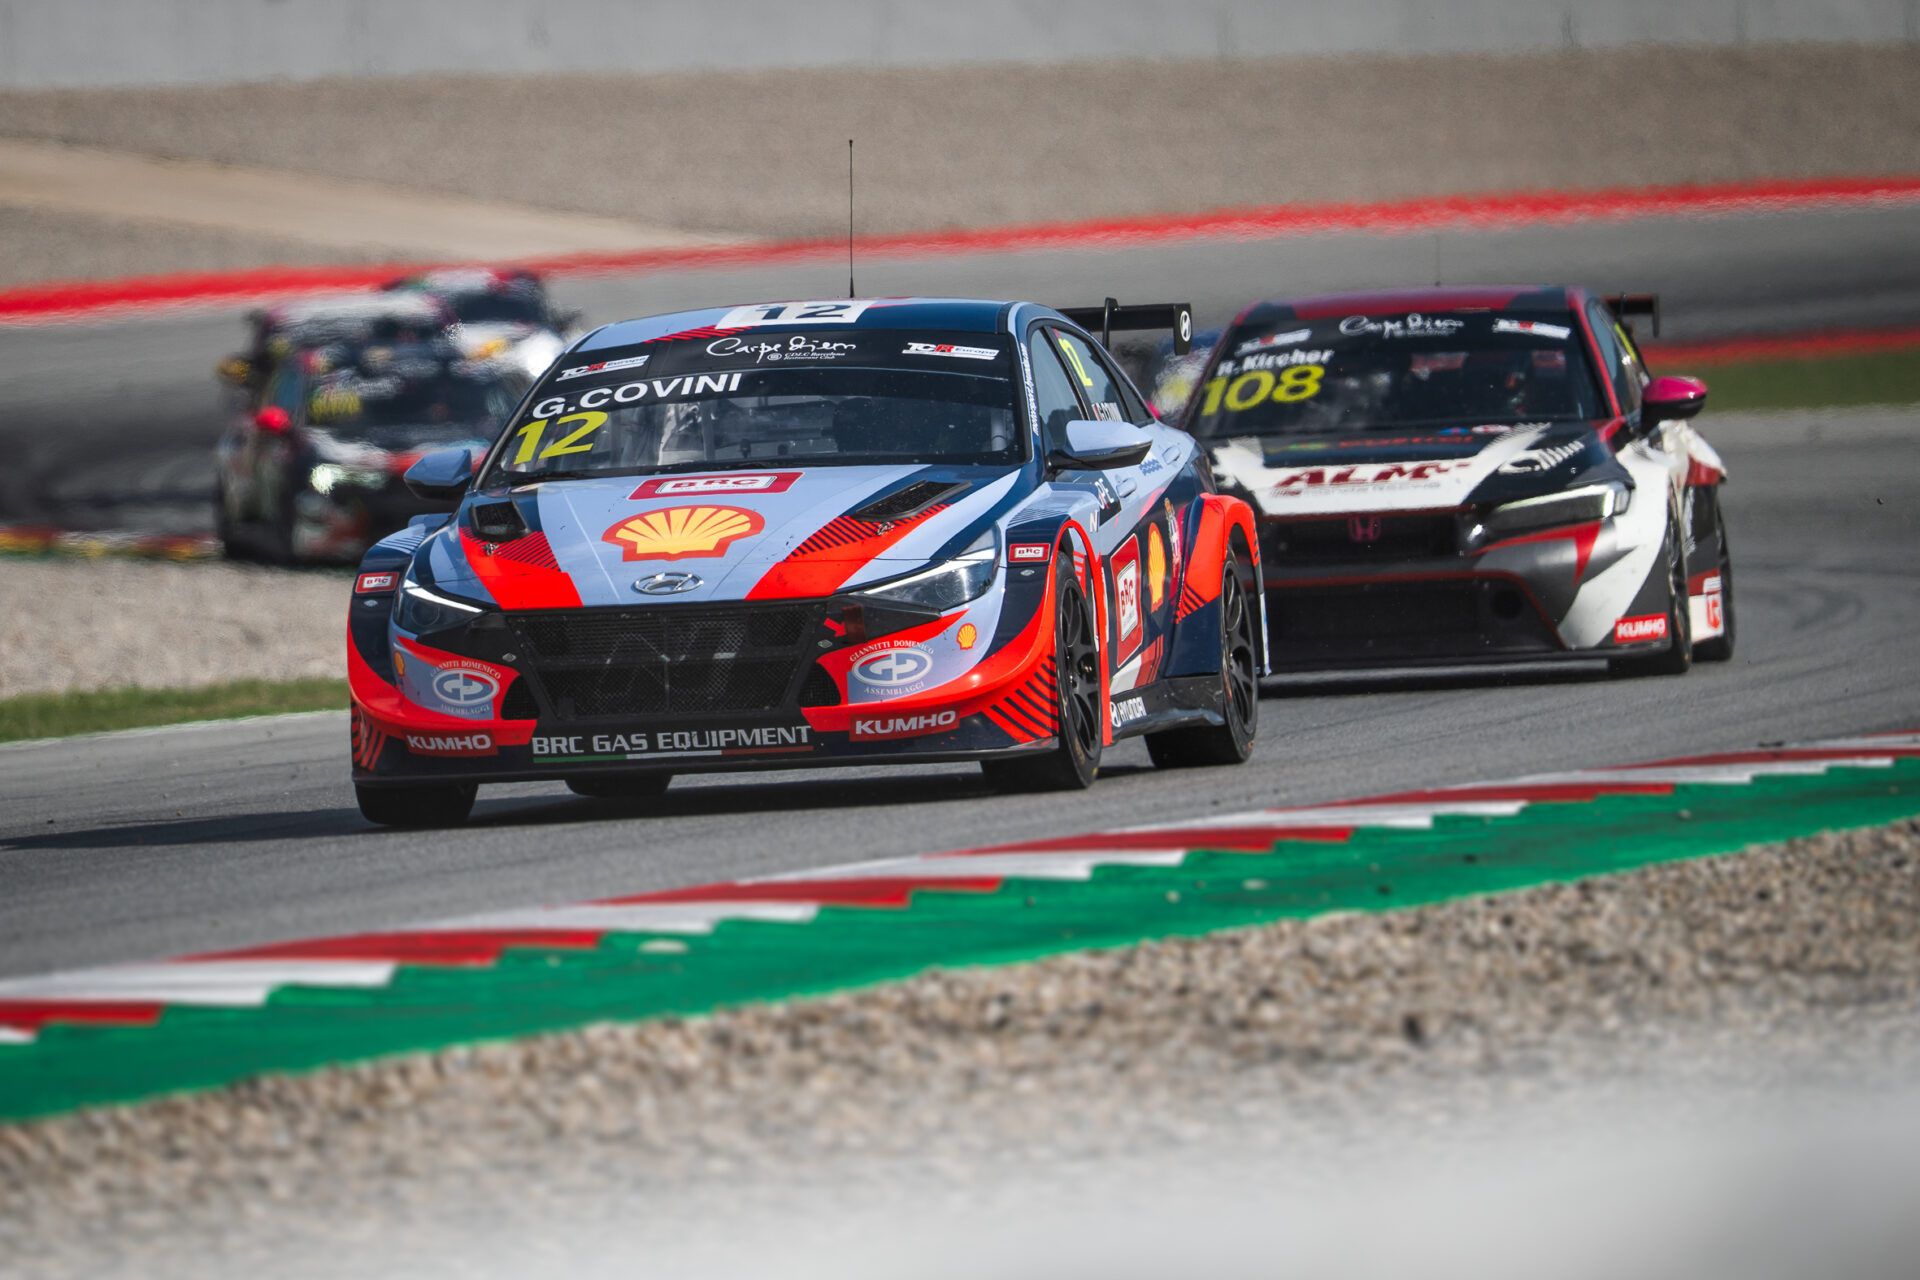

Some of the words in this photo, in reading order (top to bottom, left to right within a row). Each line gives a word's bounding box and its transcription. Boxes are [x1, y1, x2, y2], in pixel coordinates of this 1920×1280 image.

[756, 304, 845, 321] 12
[706, 337, 781, 364] Carpe
[789, 336, 857, 352] Diem
[907, 342, 955, 353] TCR
[955, 346, 997, 356] Europe
[561, 362, 607, 377] TCR
[607, 357, 646, 367] Europe
[532, 373, 742, 419] G.COVINI
[1202, 364, 1325, 416] 108
[514, 411, 608, 465] 12
[672, 478, 757, 488] BRC
[366, 577, 389, 585] BRC
[1121, 578, 1135, 616] BRC
[1617, 618, 1665, 638] KUMHO
[849, 641, 891, 662] GIANNITTI
[893, 640, 934, 655] DOMENICO
[864, 680, 925, 696] ASSEMBLAGGI
[856, 710, 956, 734] KUMHO
[406, 734, 491, 750] KUMHO
[532, 736, 584, 754] BRC
[592, 733, 648, 752] GAS
[657, 725, 812, 750] EQUIPMENT
